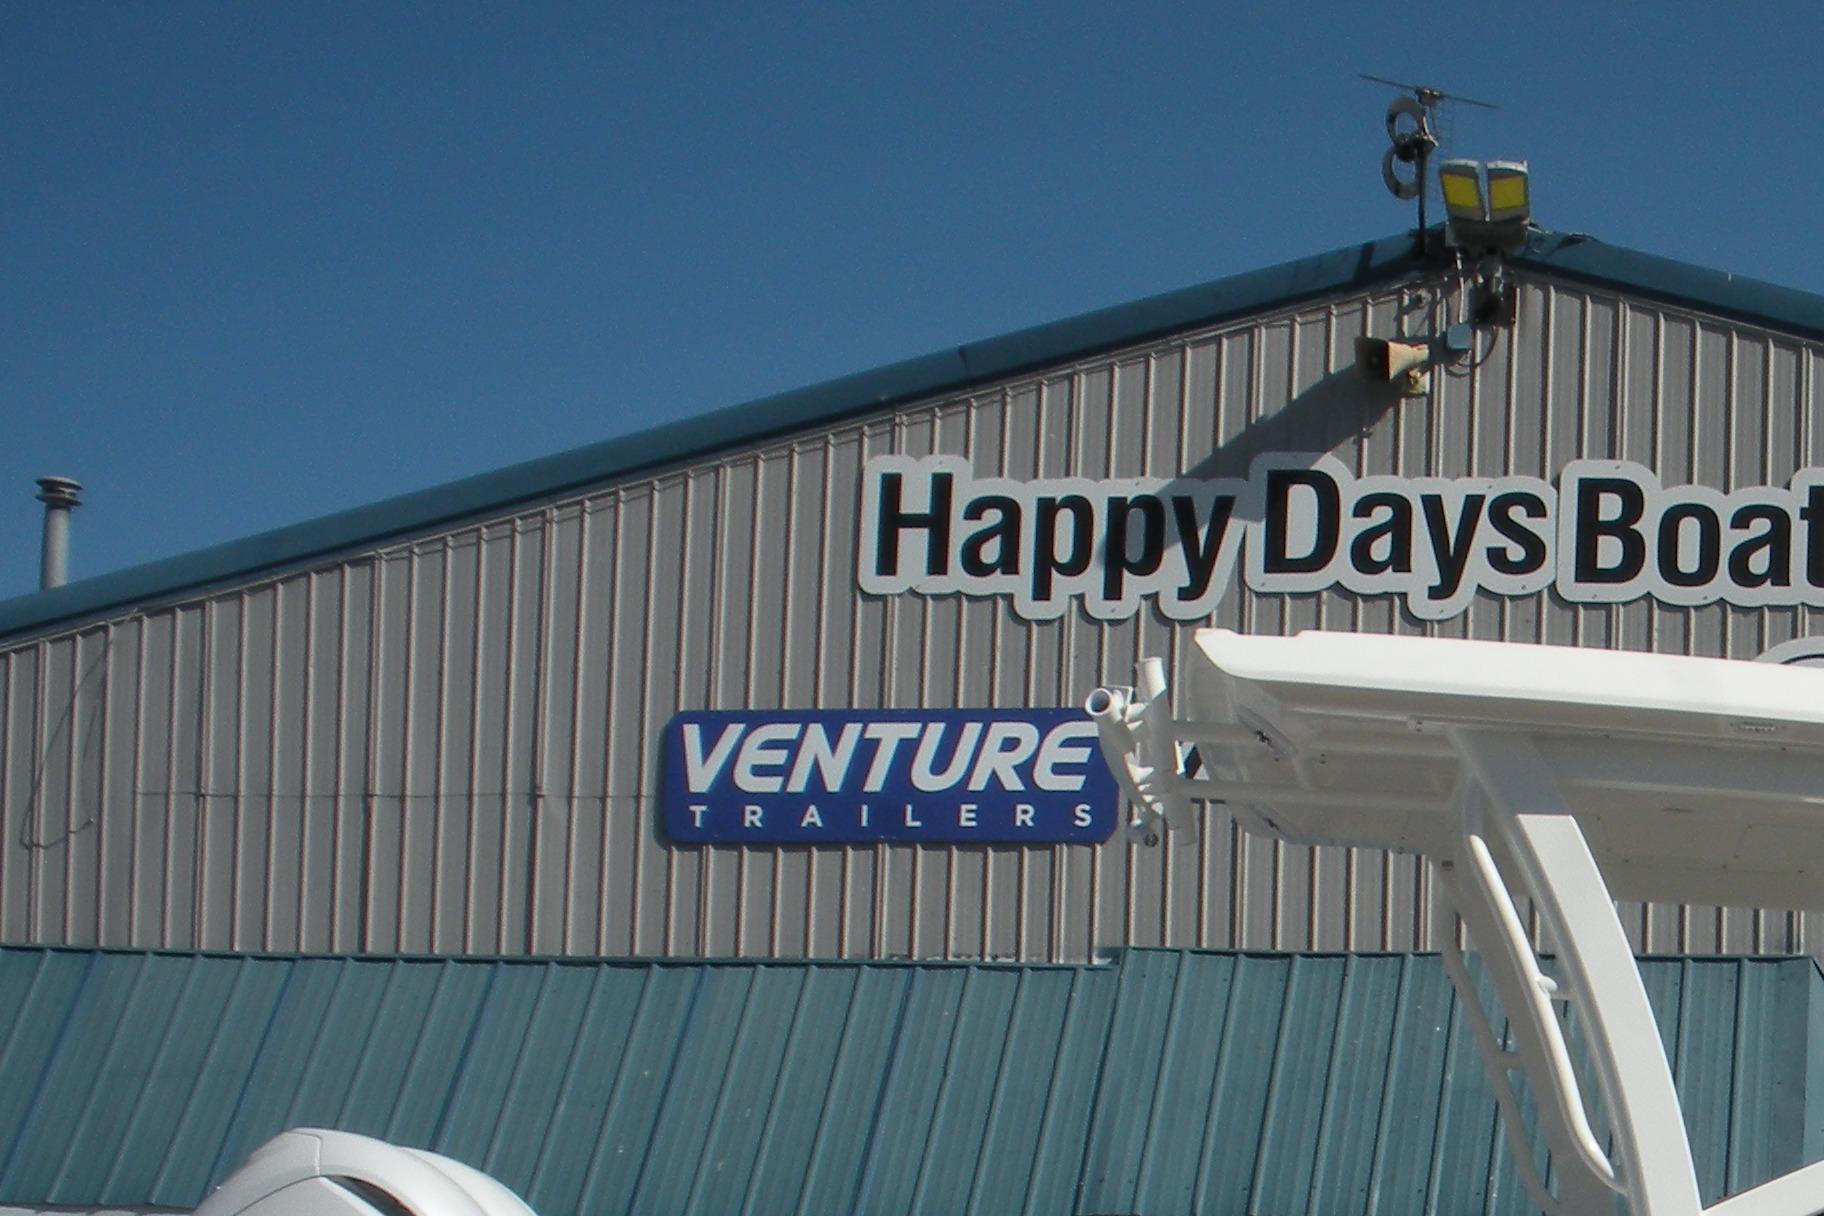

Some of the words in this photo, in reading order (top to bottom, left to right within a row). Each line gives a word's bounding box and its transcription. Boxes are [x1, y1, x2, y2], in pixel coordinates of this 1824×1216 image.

[874, 471, 1236, 602] Happy
[1263, 468, 1549, 602] Days
[682, 720, 1101, 795] VENTURE
[689, 804, 1093, 829] TRAILERS
